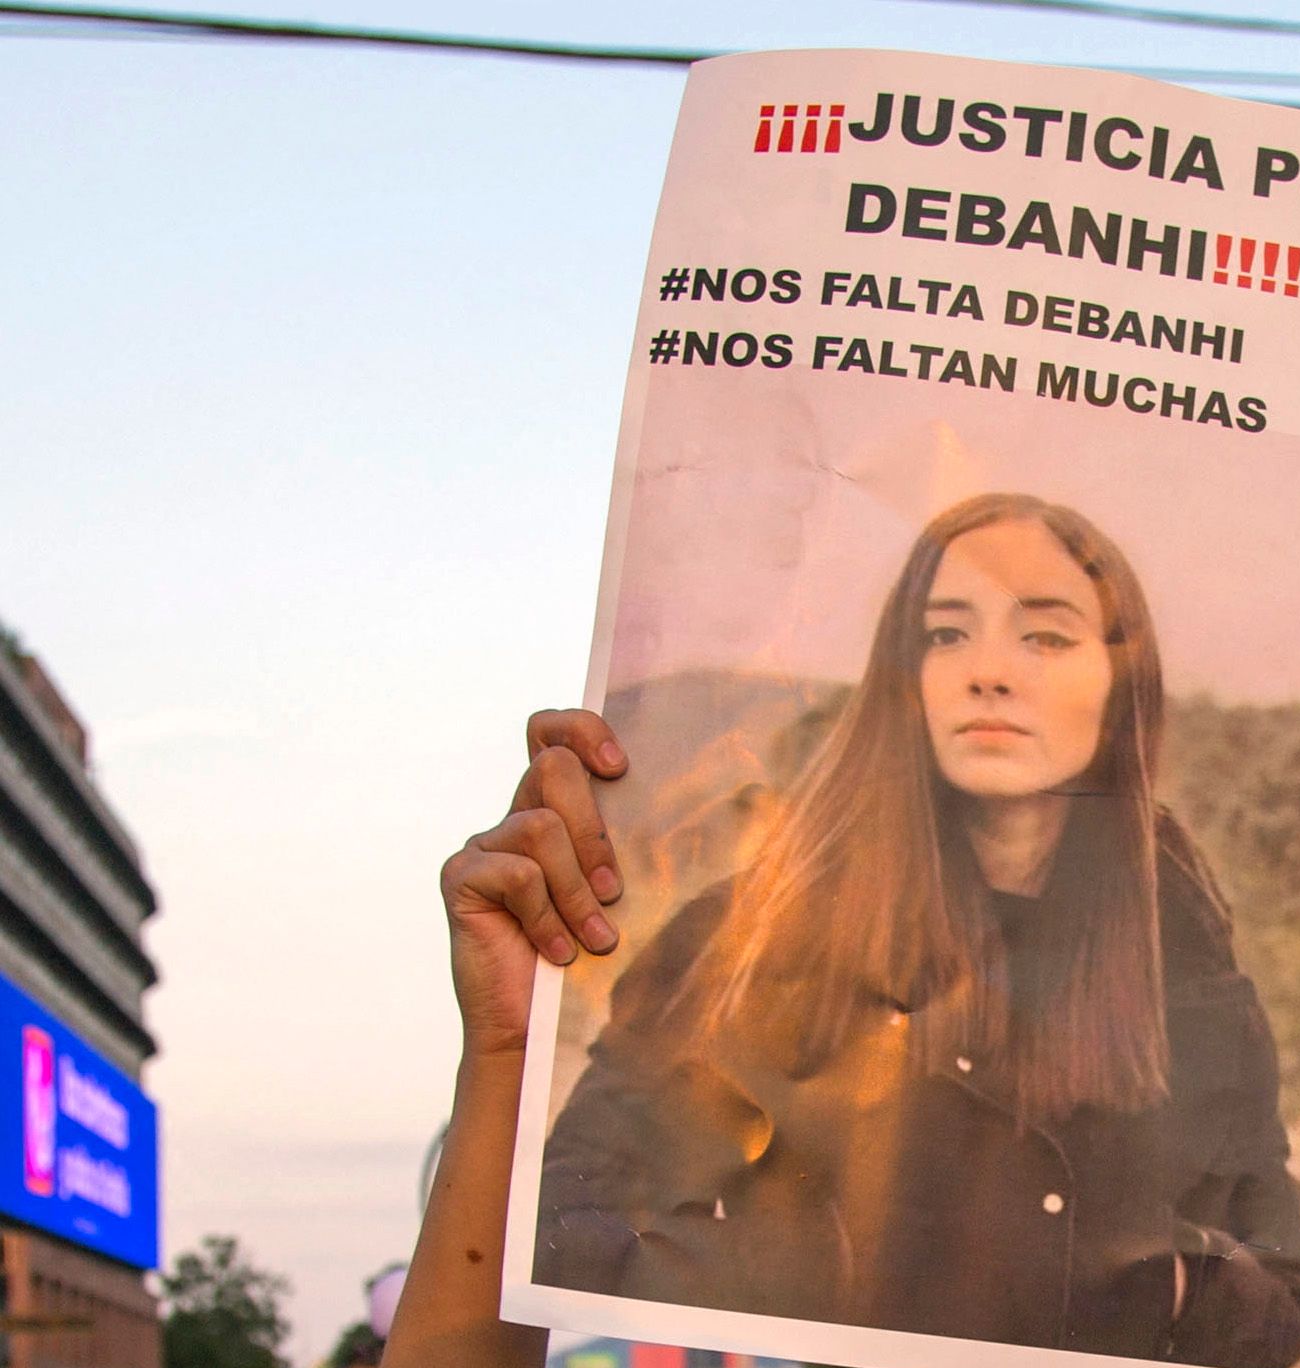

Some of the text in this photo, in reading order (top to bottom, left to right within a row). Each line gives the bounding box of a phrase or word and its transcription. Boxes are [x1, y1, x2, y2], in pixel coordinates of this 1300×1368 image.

[754, 94, 1224, 191] ¡¡¡¡JUSTICIA
[659, 267, 1244, 364] #NOS FALTA DEBANHI
[649, 329, 1267, 433] #NOS FALTAN MUCHAS
